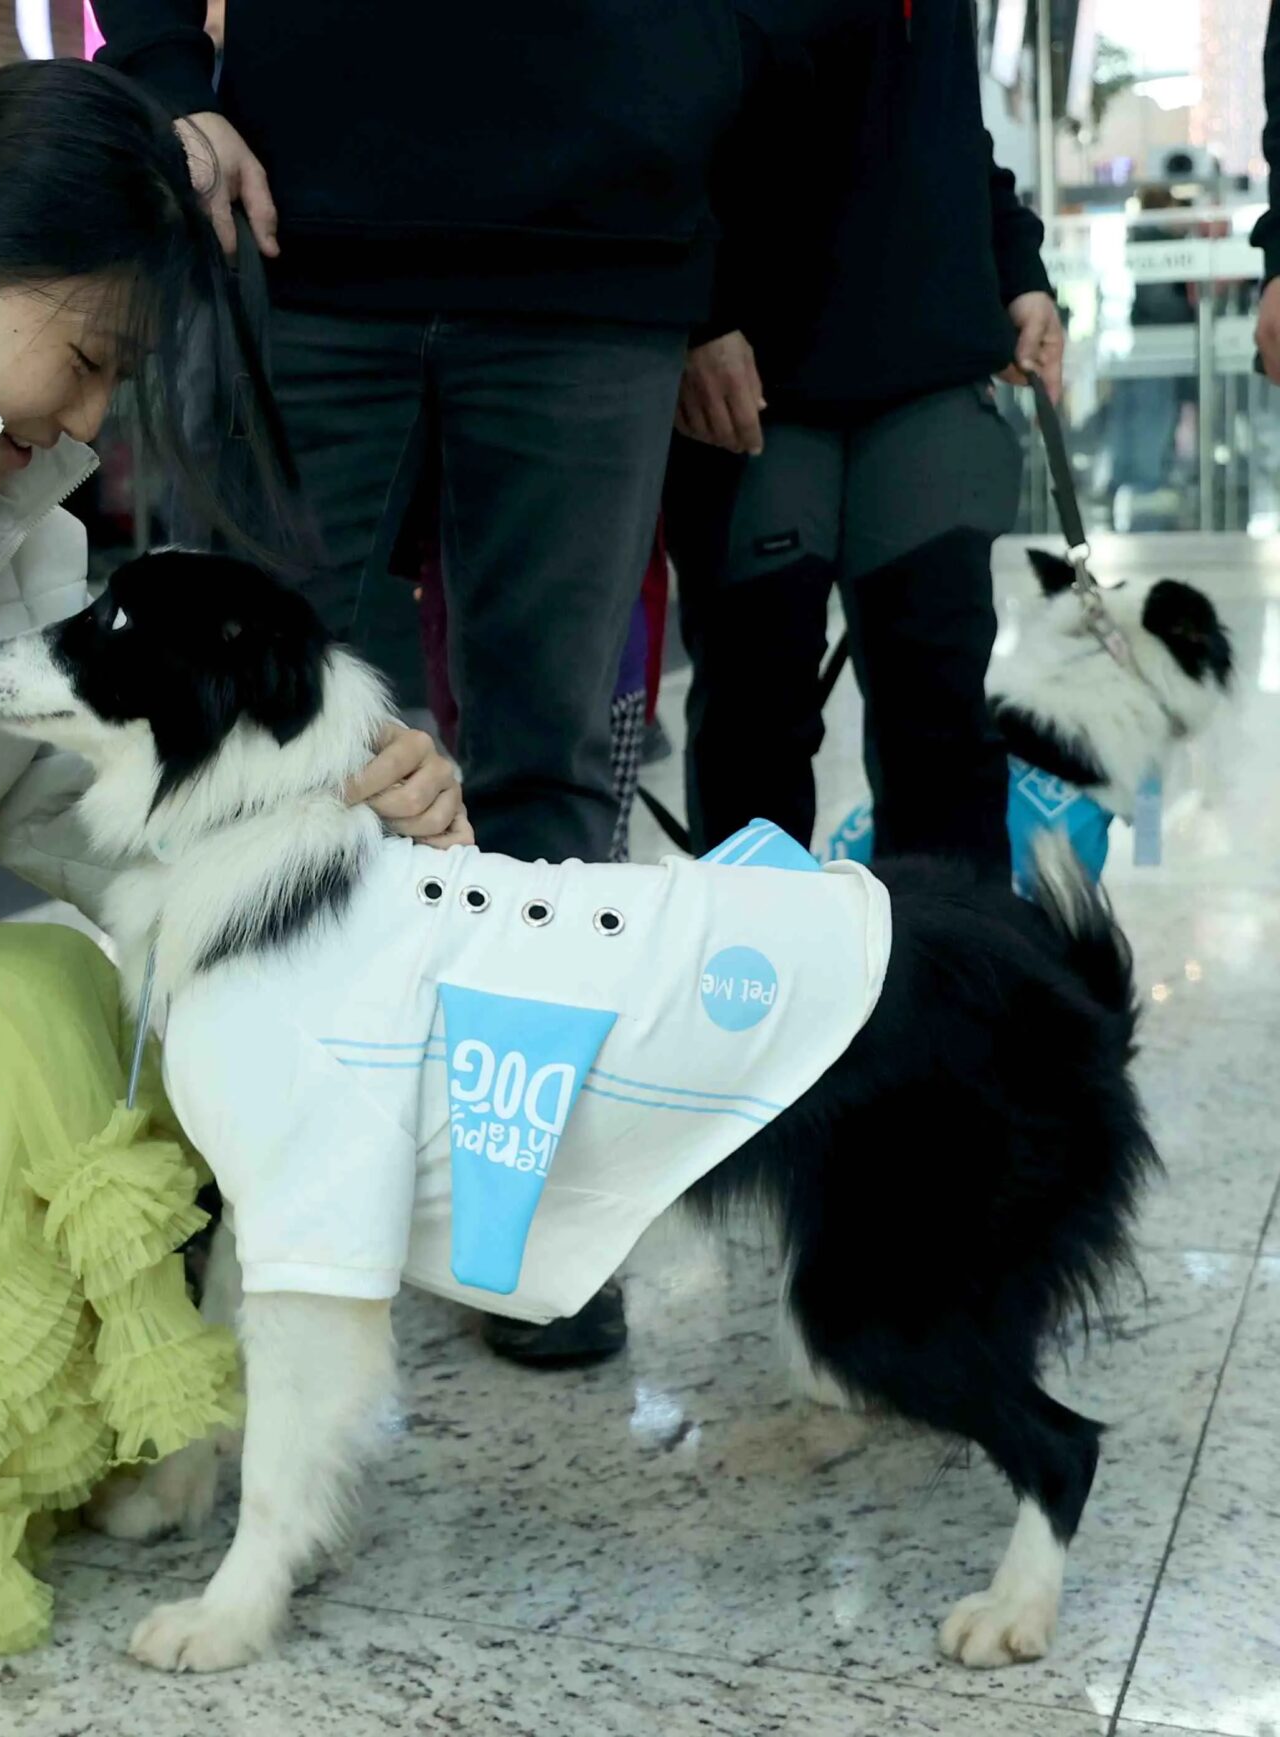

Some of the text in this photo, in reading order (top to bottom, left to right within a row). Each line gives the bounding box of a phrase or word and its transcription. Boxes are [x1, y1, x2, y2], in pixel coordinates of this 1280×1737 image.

[701, 974, 777, 1005] Pet Me
[451, 1039, 576, 1136] DOG
